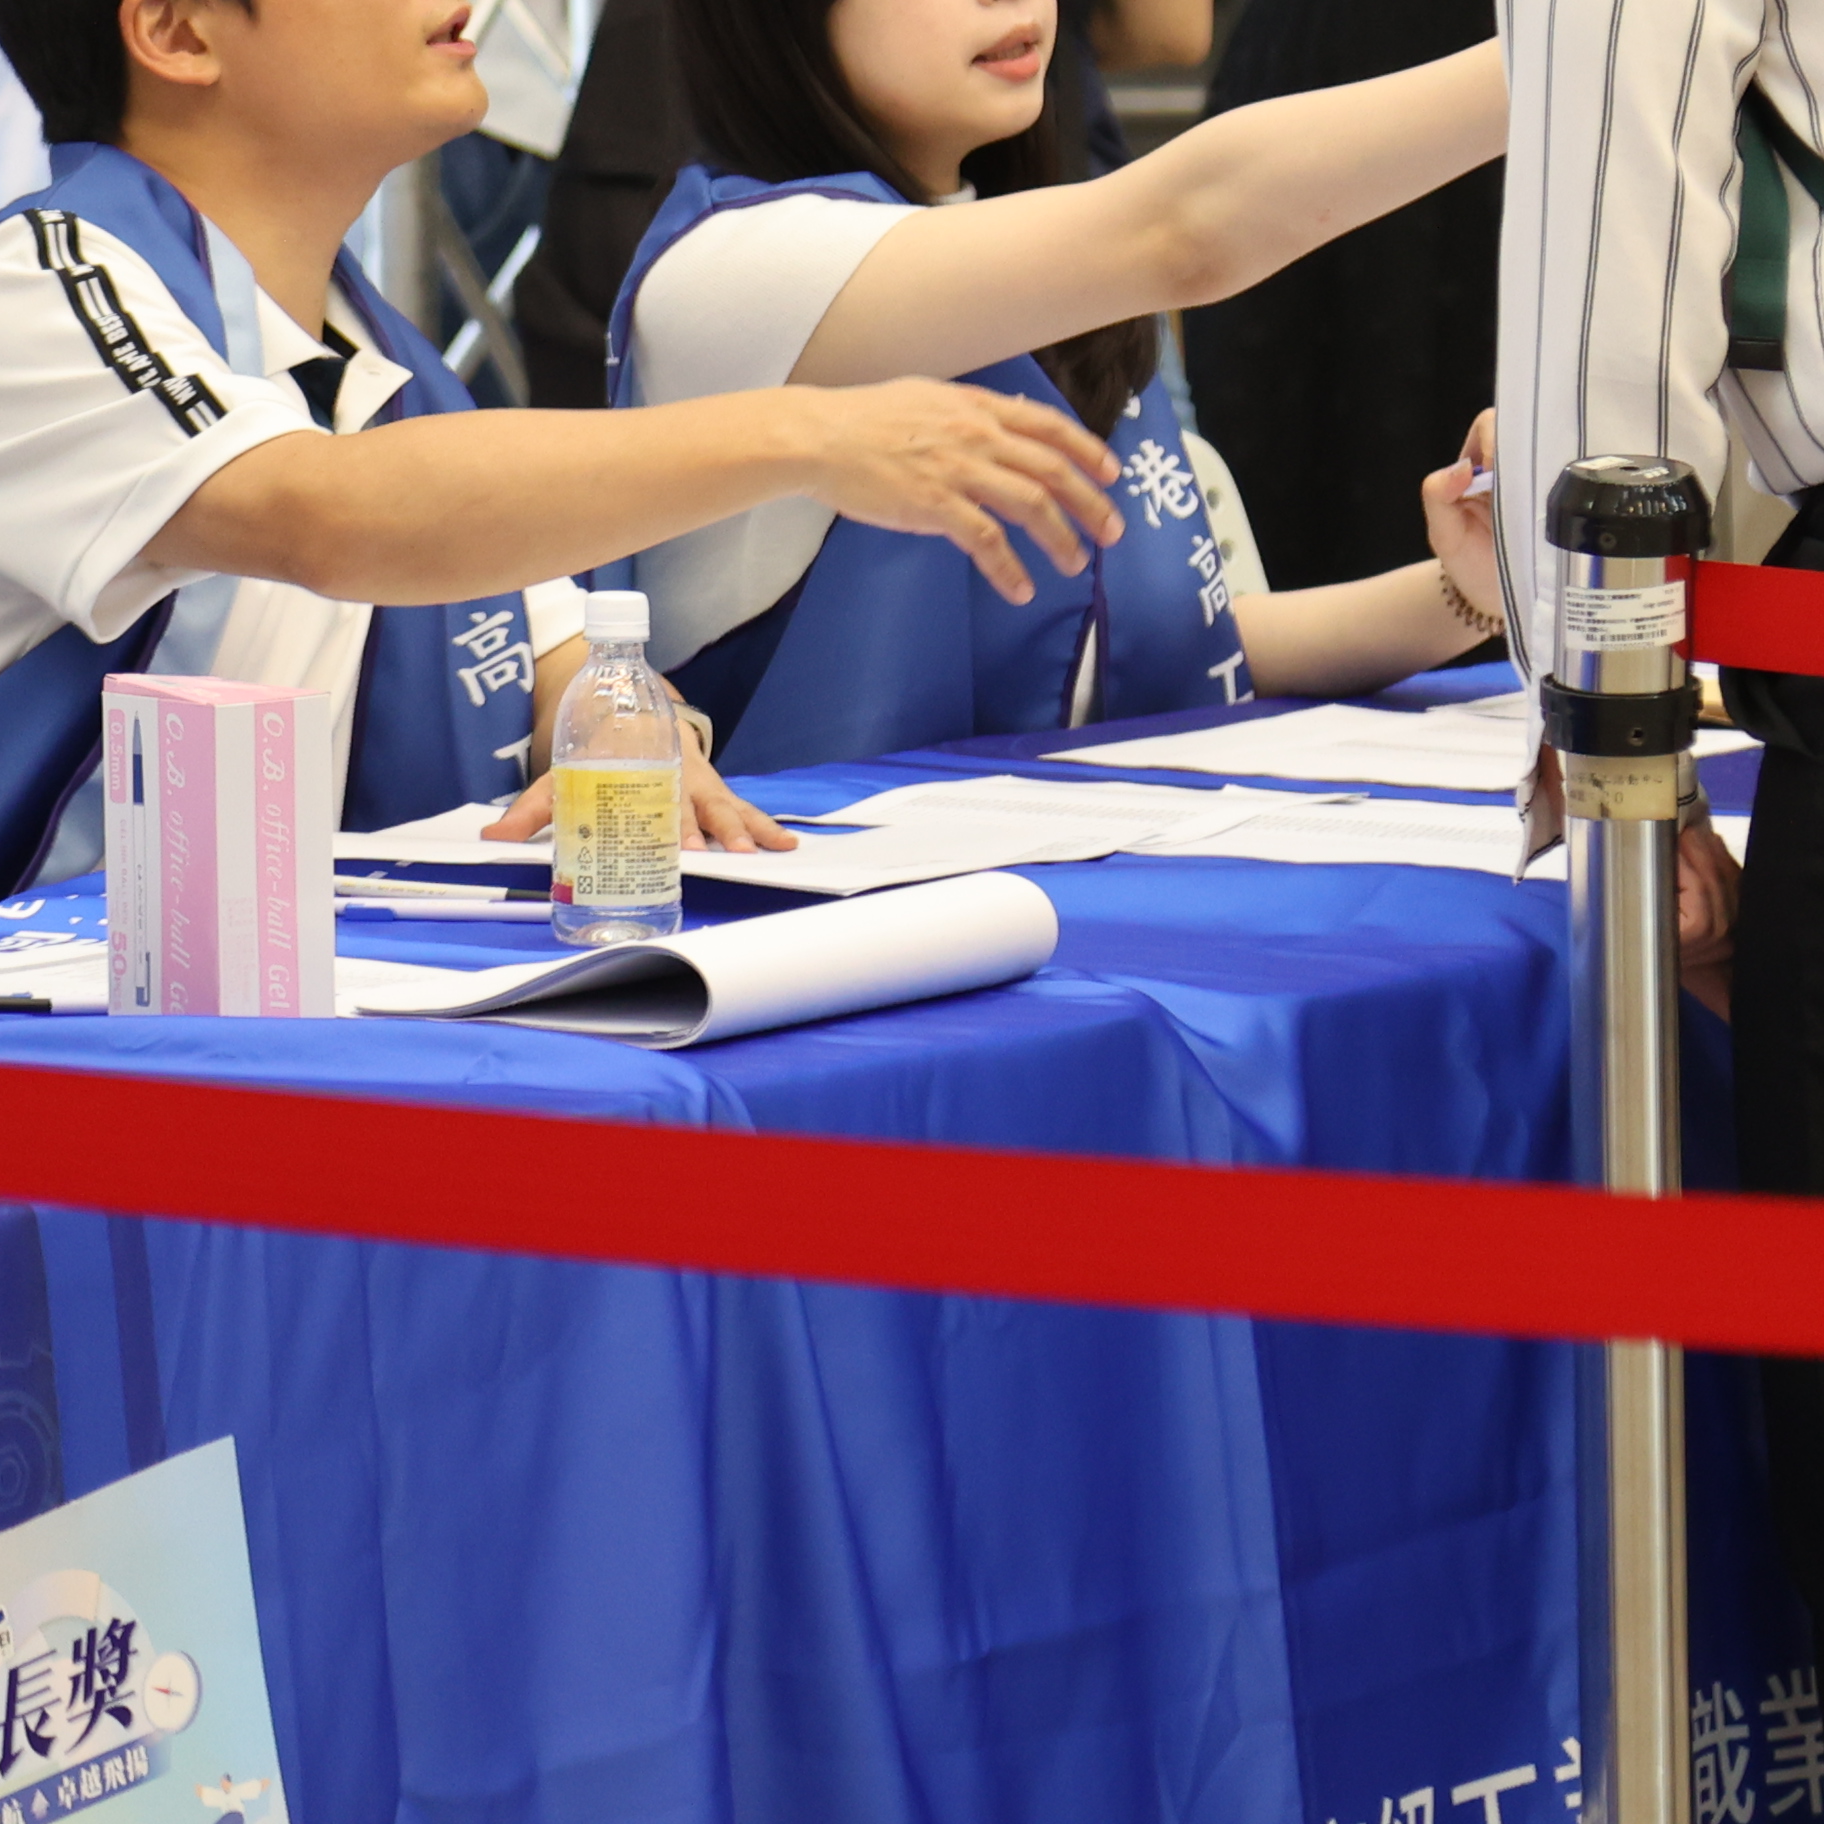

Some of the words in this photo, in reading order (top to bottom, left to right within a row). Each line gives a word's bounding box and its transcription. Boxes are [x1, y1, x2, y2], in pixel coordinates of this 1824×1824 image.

[110, 722, 124, 791] 0.5mm
[164, 712, 186, 796] O.B.
[262, 712, 286, 792] O.B.
[166, 810, 191, 970] office-ball
[262, 803, 292, 951] office-ball
[268, 963, 291, 1010] Gel
